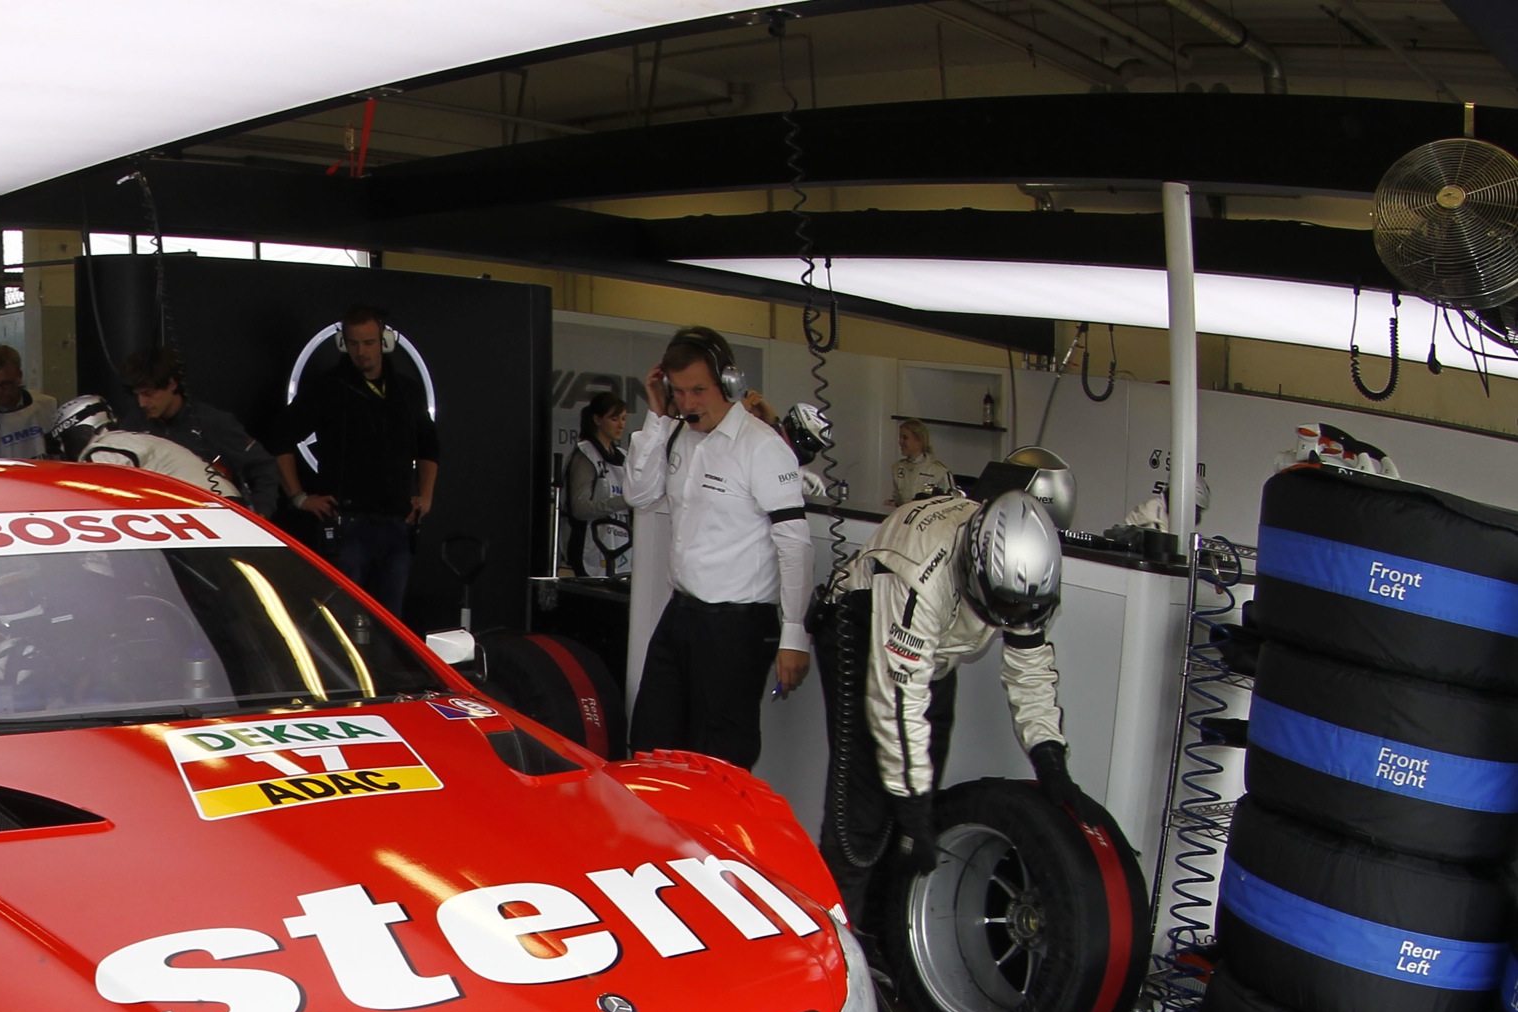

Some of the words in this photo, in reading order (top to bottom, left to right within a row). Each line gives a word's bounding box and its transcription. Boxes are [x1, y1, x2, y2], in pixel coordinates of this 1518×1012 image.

[1, 426, 44, 444] DMS
[51, 414, 80, 437] uvex
[778, 471, 799, 483] BOSS
[1035, 495, 1054, 505] vex
[919, 547, 947, 585] PETRONAS
[1370, 561, 1422, 588] Front
[1368, 578, 1406, 600] Left
[889, 622, 924, 650] SYNTIUM
[588, 698, 601, 727] Rear
[182, 720, 389, 752] DEKRA
[245, 745, 349, 777] 17
[1377, 747, 1430, 773] Front
[257, 770, 401, 806] ADAC
[1375, 762, 1426, 789] Right
[1400, 940, 1441, 961] Rear
[1396, 956, 1431, 976] Left
